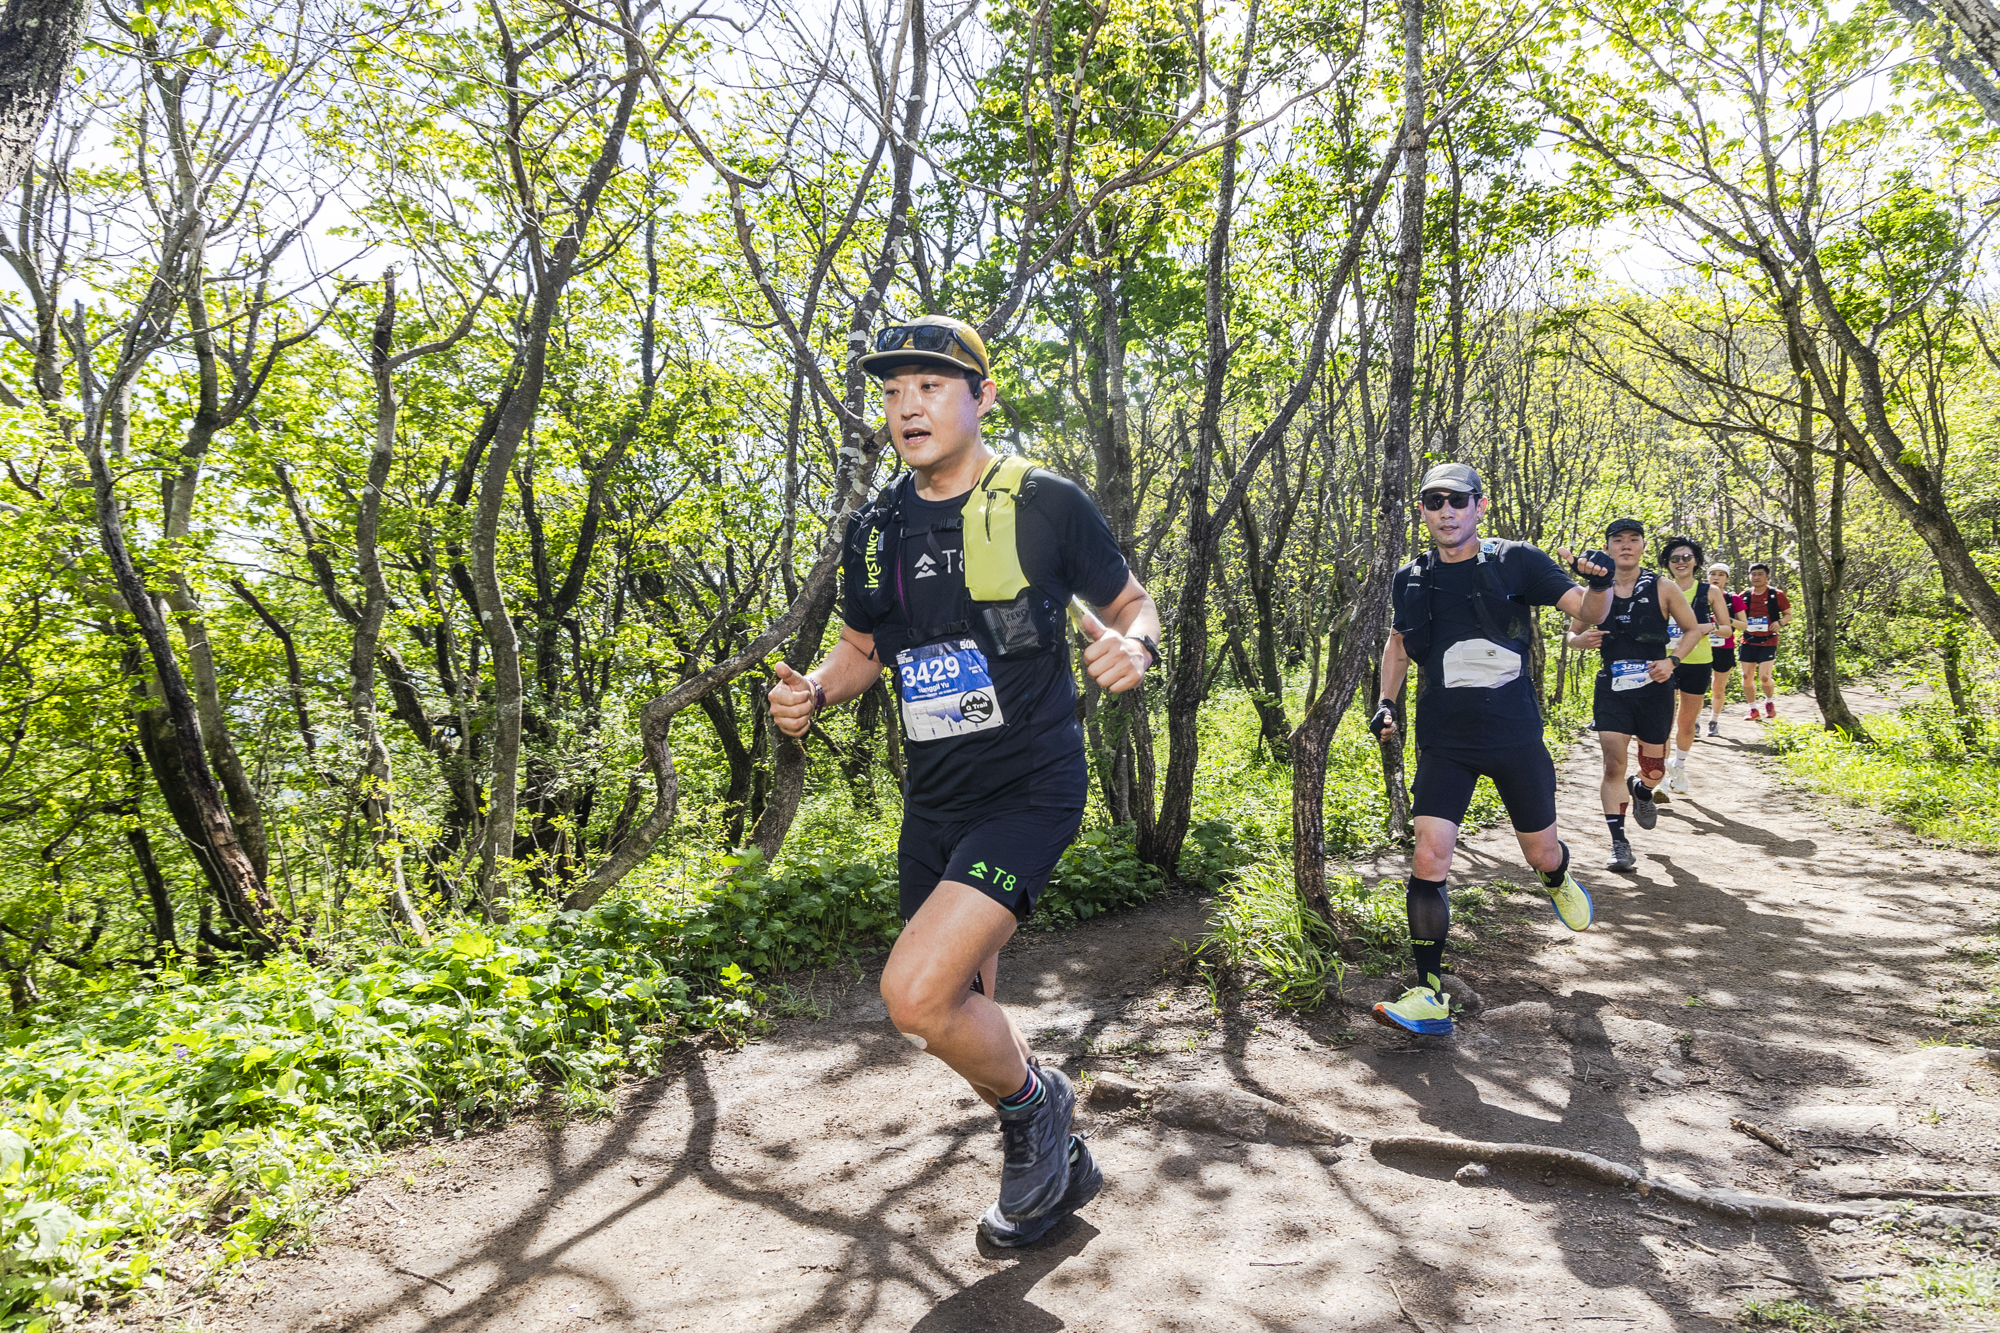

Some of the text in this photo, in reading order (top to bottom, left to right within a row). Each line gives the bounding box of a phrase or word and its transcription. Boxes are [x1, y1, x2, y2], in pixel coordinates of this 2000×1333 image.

[901, 656, 960, 687] 3429
[972, 701, 988, 710] Trail
[993, 866, 1017, 892] T8
